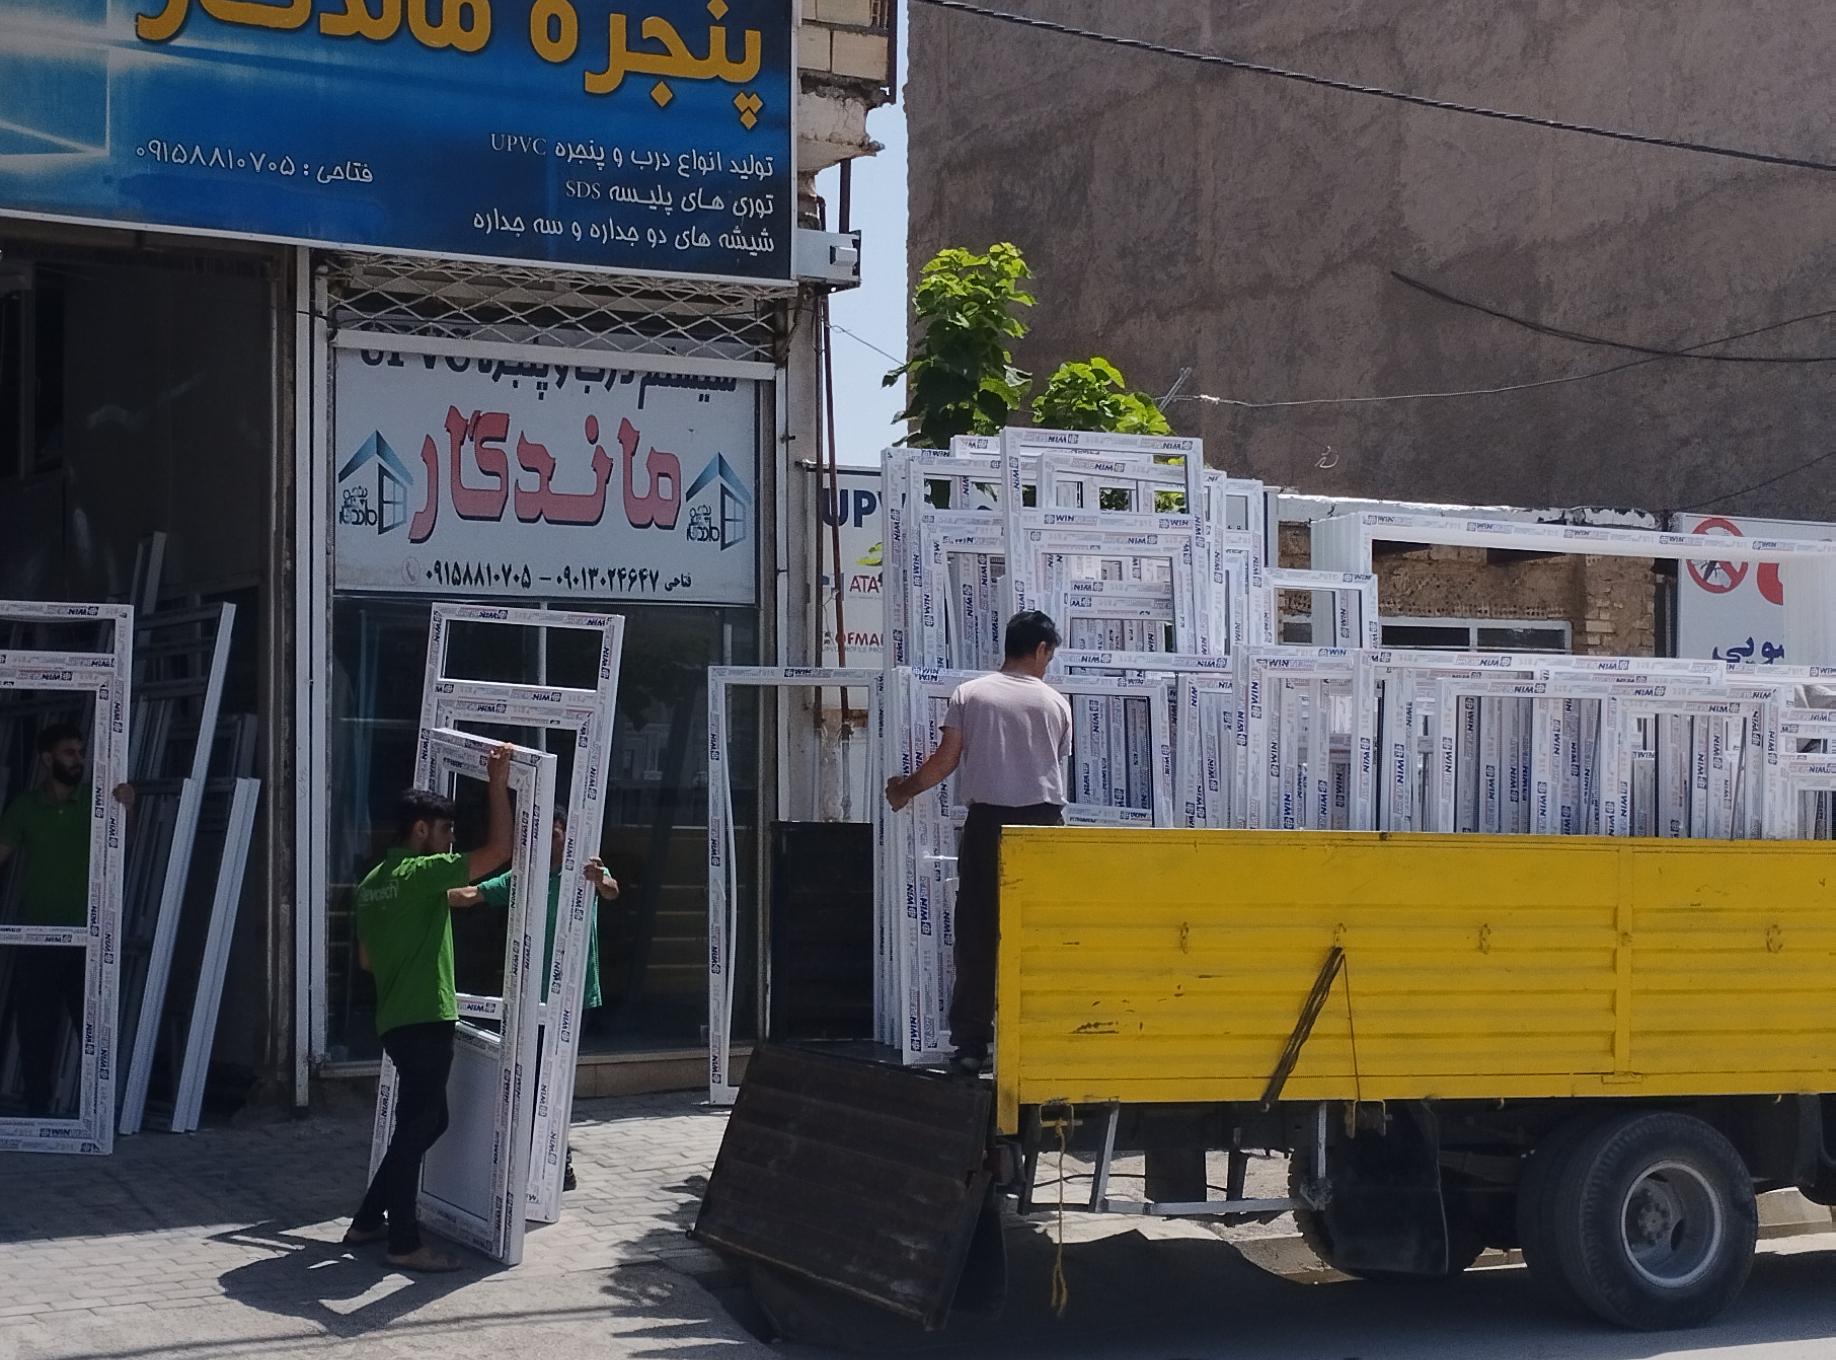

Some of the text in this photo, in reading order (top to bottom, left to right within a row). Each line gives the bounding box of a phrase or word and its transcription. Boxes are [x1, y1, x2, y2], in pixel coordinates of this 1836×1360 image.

[137, 139, 296, 175] ۰۹۱۵۸۸۱۰۷۰۵
[316, 161, 374, 184] فتاحی
[491, 133, 774, 181] تولید انواع درب و پنجره UPVC
[565, 180, 774, 219] توری های پلیسه SDS
[474, 207, 775, 257] شیشه های دو جداره و سه جداره
[408, 405, 682, 544] ماندگار
[823, 488, 882, 528] UP
[426, 560, 532, 589] ۰۹۱۵۸۸۱۰۷۰۵
[664, 574, 692, 592] فتاحی
